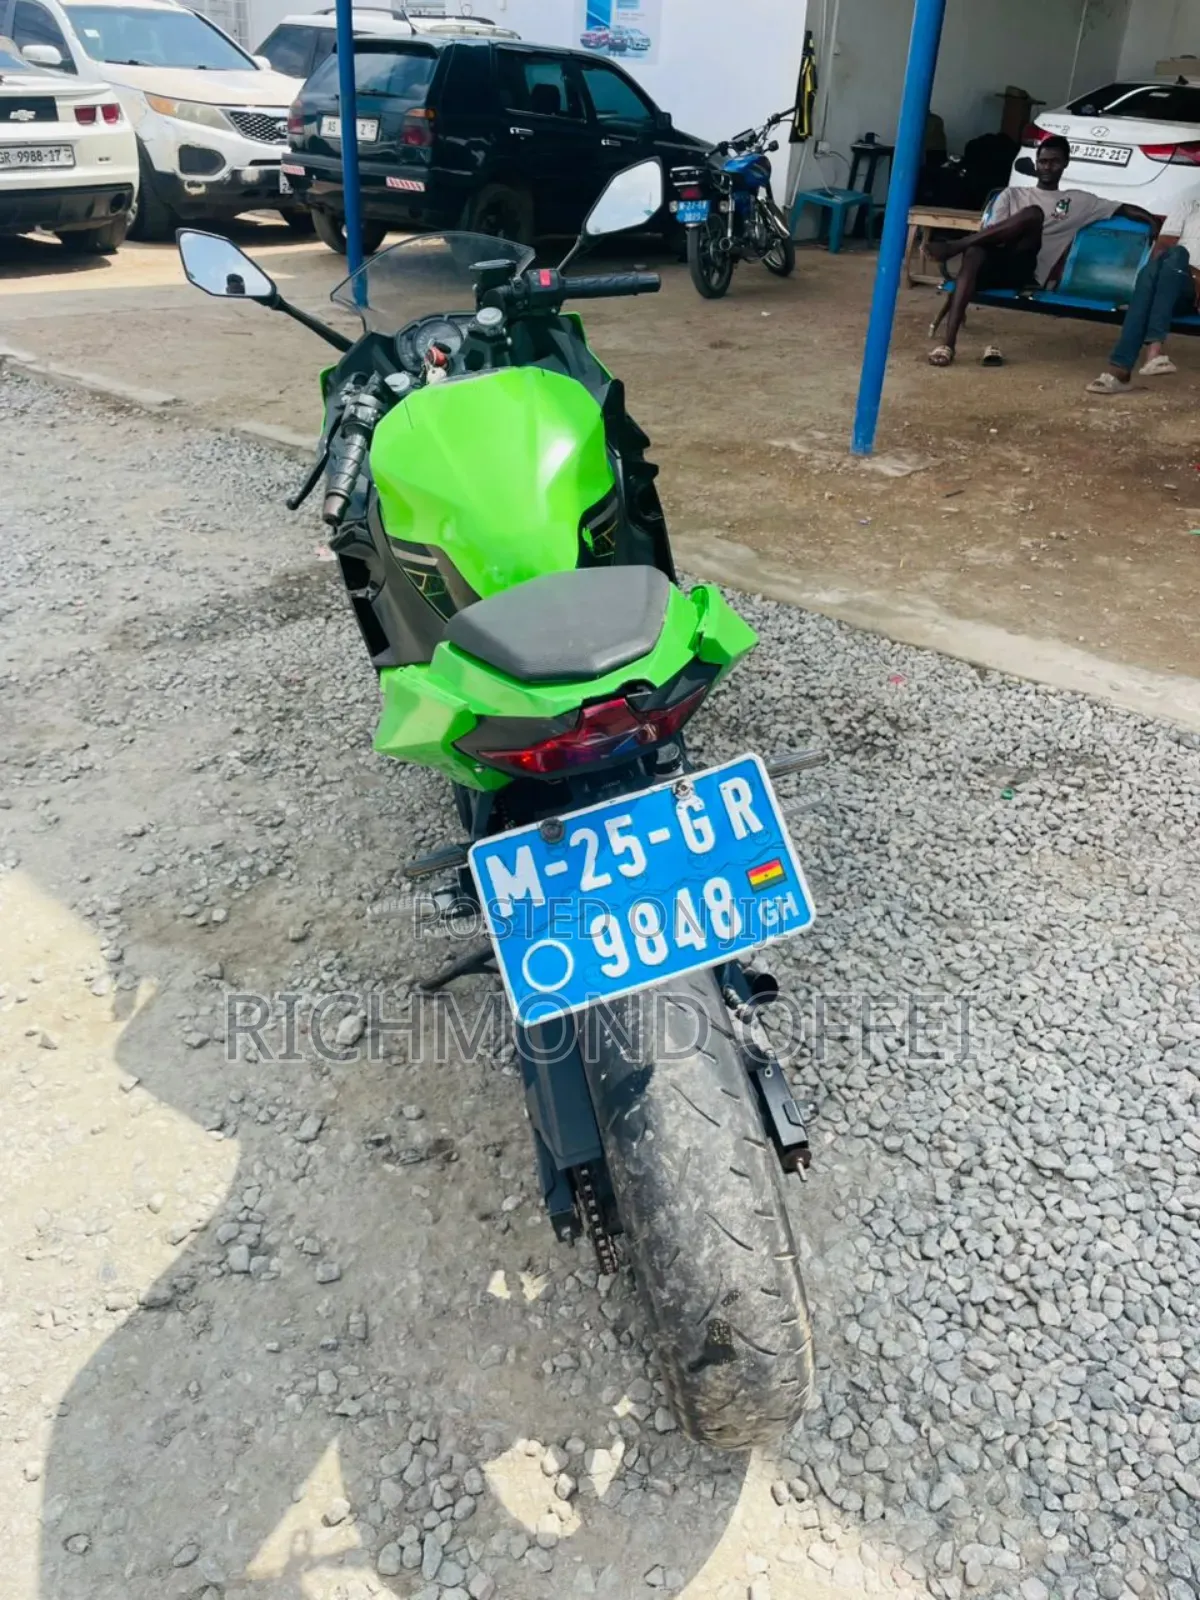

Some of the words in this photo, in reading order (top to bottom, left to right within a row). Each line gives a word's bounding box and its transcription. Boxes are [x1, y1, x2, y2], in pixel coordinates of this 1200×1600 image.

[17, 149, 60, 163] 9988-17
[1083, 147, 1121, 161] 1212-21
[758, 892, 799, 927] GH
[590, 877, 742, 978] 9848
